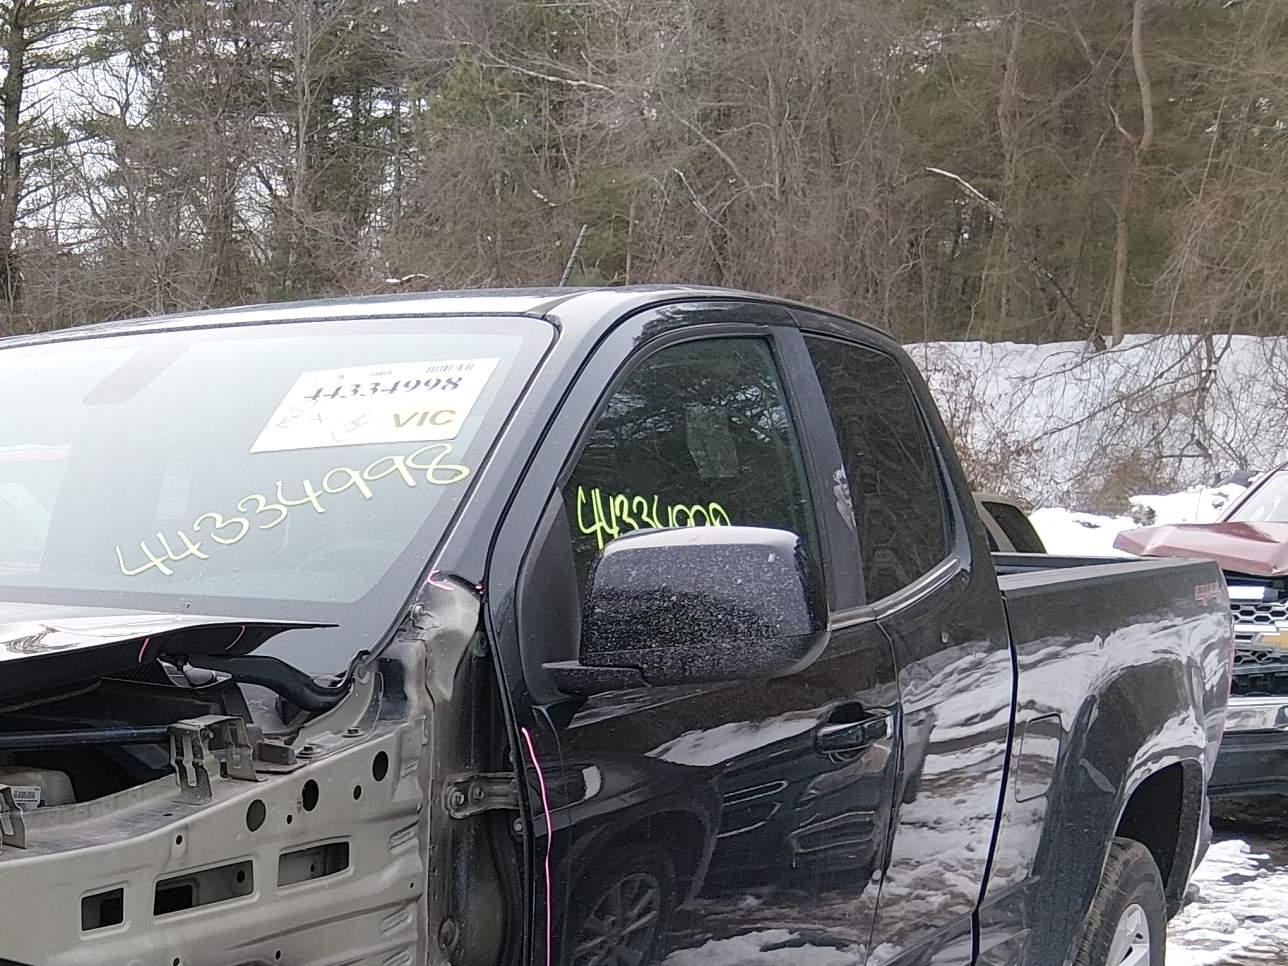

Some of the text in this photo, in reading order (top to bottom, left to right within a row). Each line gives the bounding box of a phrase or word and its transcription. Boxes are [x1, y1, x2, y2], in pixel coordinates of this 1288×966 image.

[303, 376, 463, 401] 44334998
[392, 409, 457, 429] VIC
[114, 443, 471, 577] 44334998
